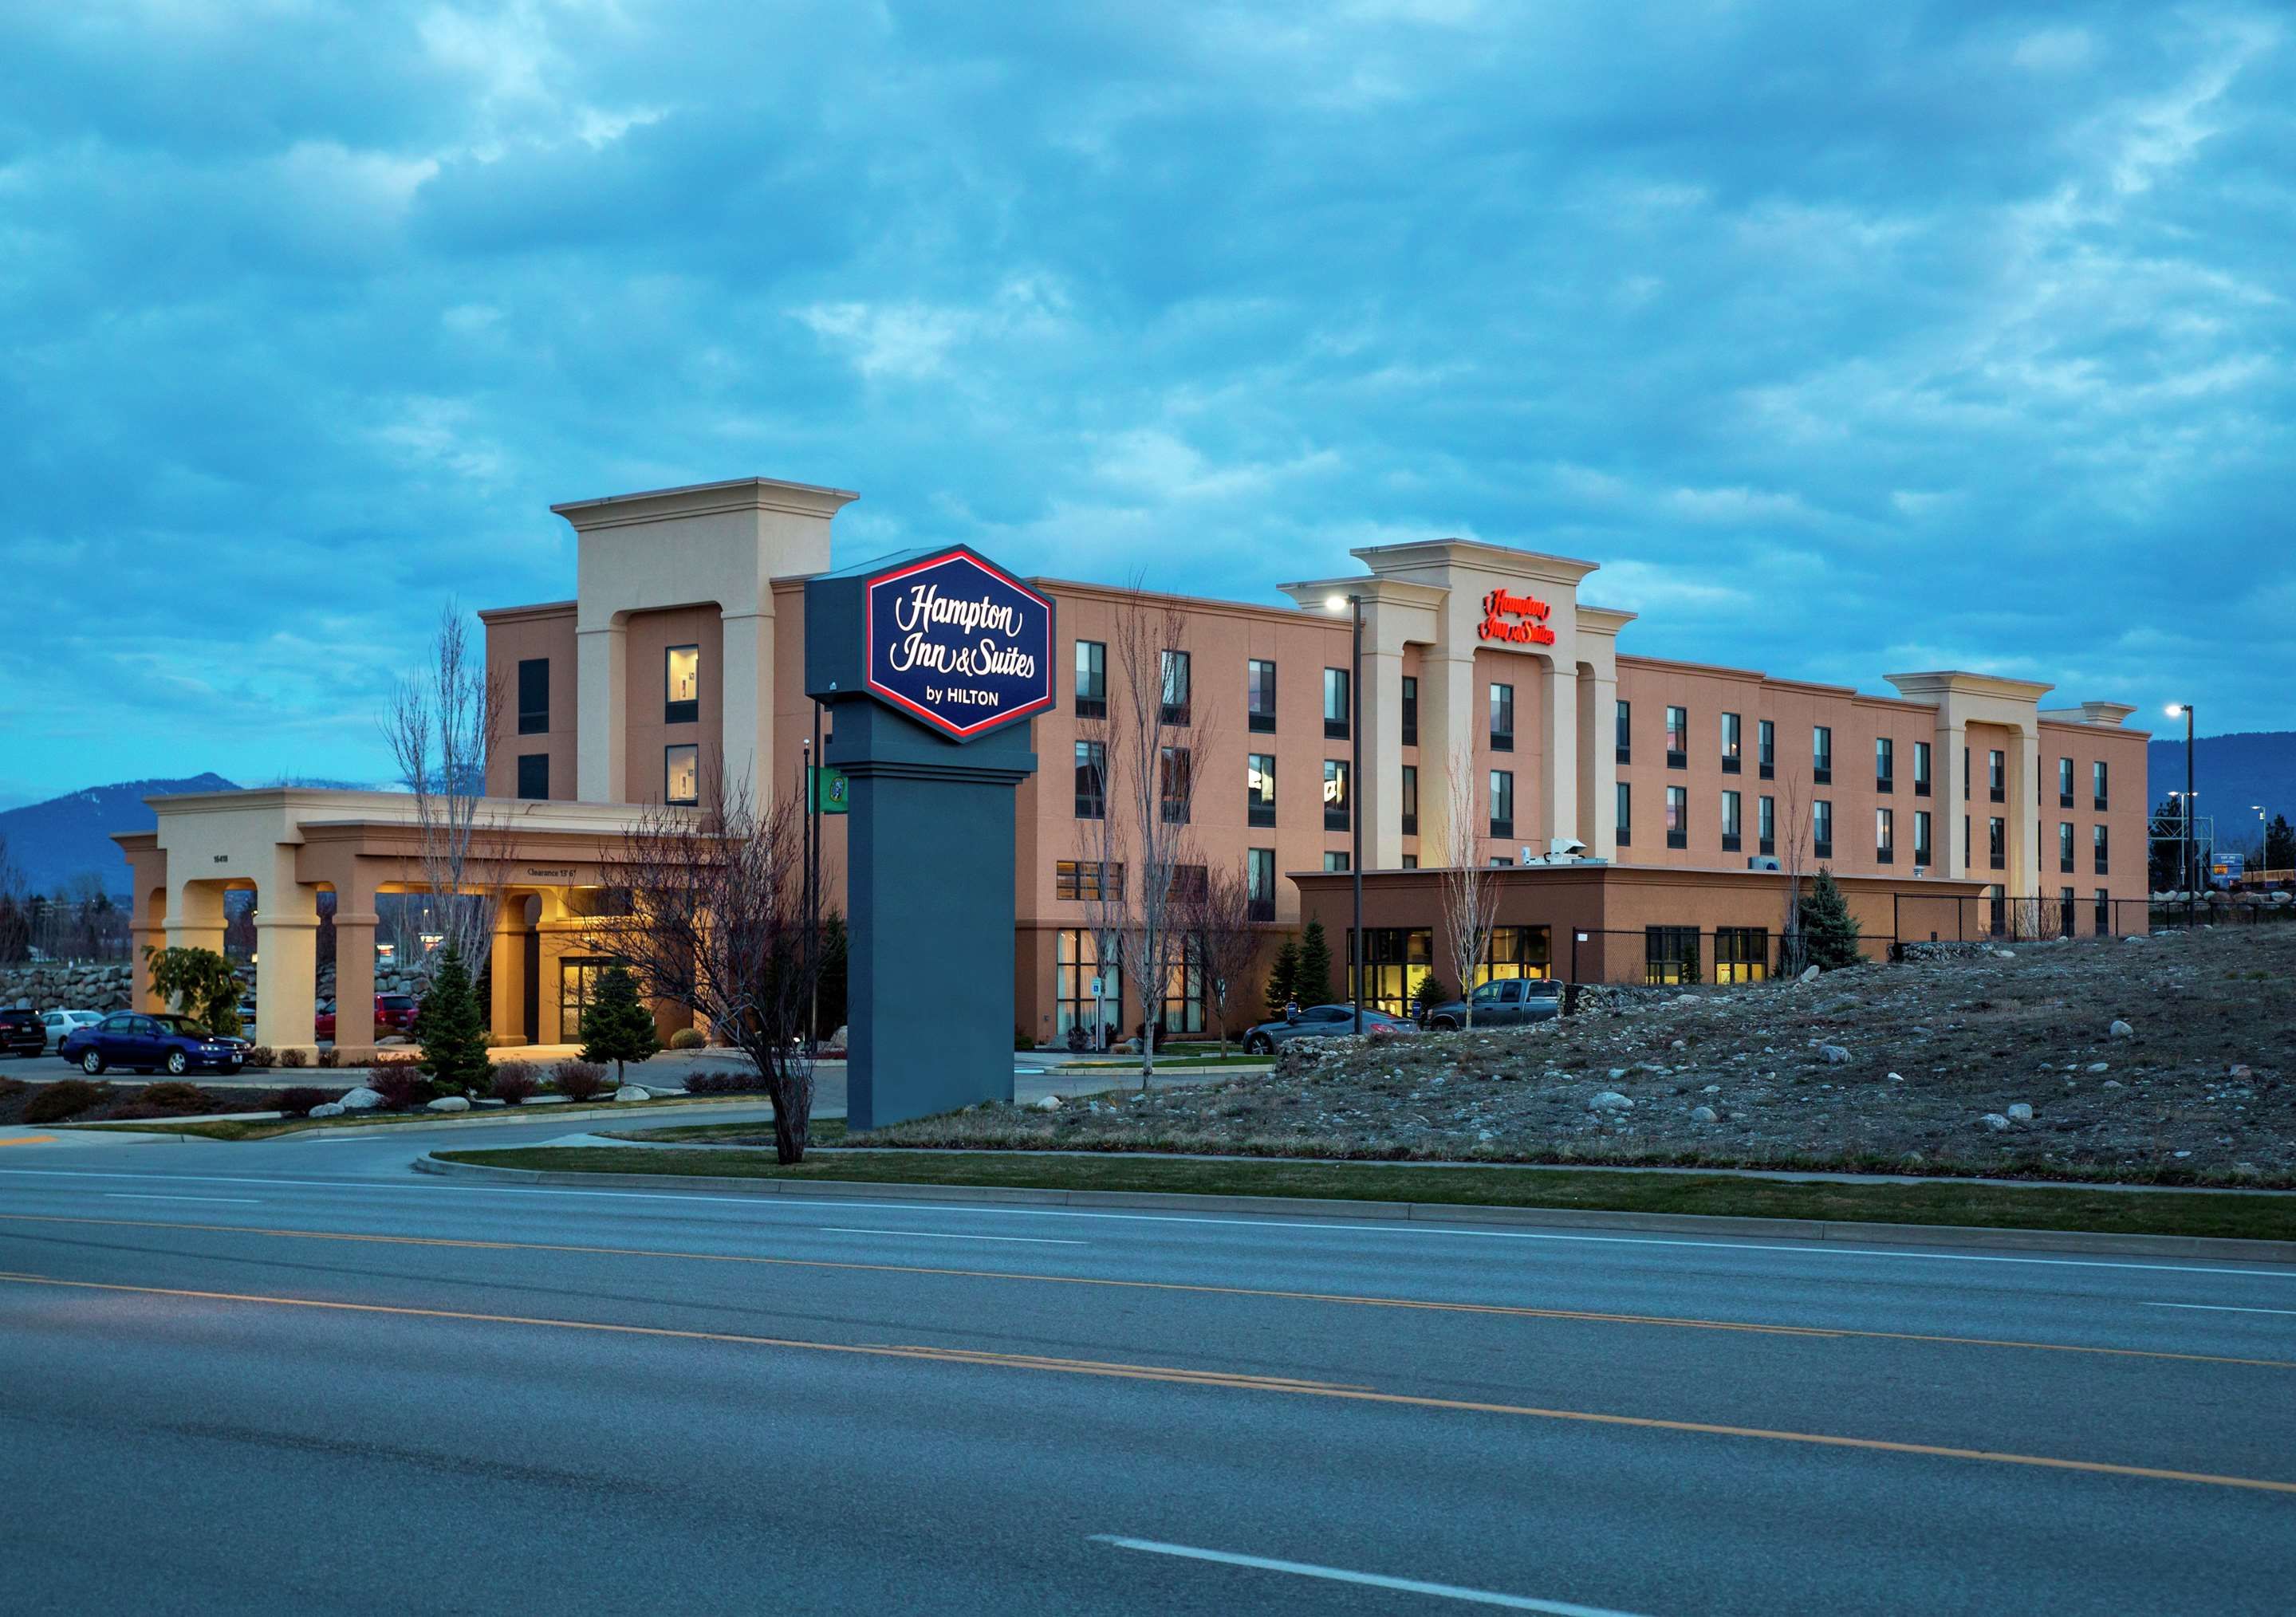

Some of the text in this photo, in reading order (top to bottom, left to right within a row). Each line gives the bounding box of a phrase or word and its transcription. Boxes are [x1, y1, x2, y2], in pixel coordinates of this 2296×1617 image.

[896, 584, 1022, 637] Hampton
[1483, 588, 1550, 620] Hampton
[890, 632, 1034, 679] Inn & Suites
[926, 686, 998, 706] by HILTON
[527, 868, 557, 877] Clearance
